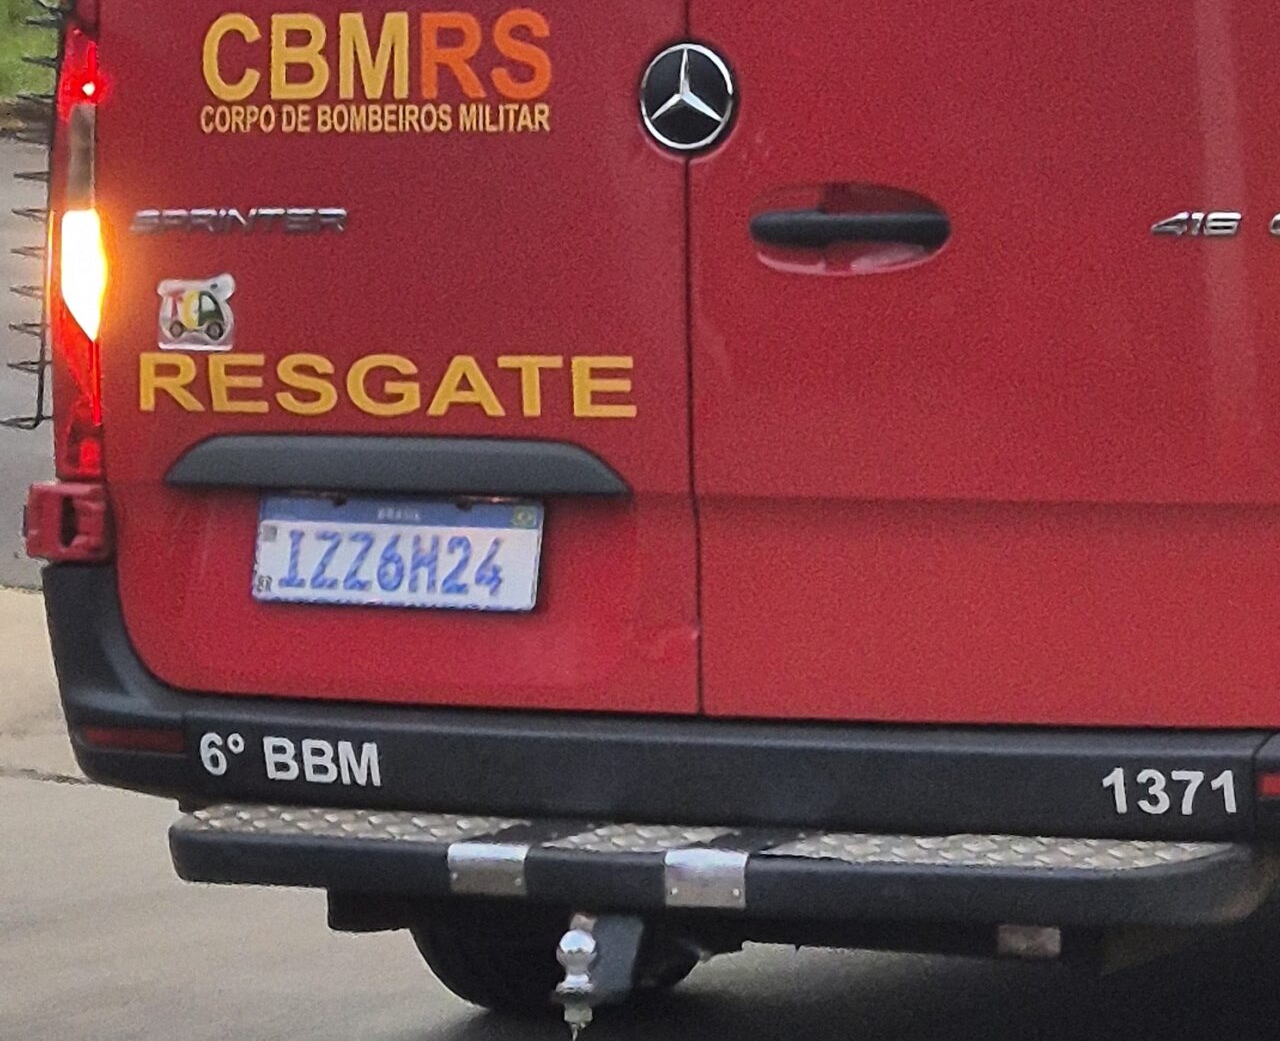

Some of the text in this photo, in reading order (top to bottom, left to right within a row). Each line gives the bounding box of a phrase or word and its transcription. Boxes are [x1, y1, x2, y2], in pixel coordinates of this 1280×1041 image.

[202, 8, 552, 102] CBMRS
[200, 103, 551, 134] CORPO DE BOMBEIROS MILITAR
[130, 208, 347, 234] SPRINTER
[138, 353, 638, 419] RESGATE
[277, 528, 504, 596] IZZ6H24
[262, 736, 382, 787] BBM
[1101, 767, 1238, 816] 1371
